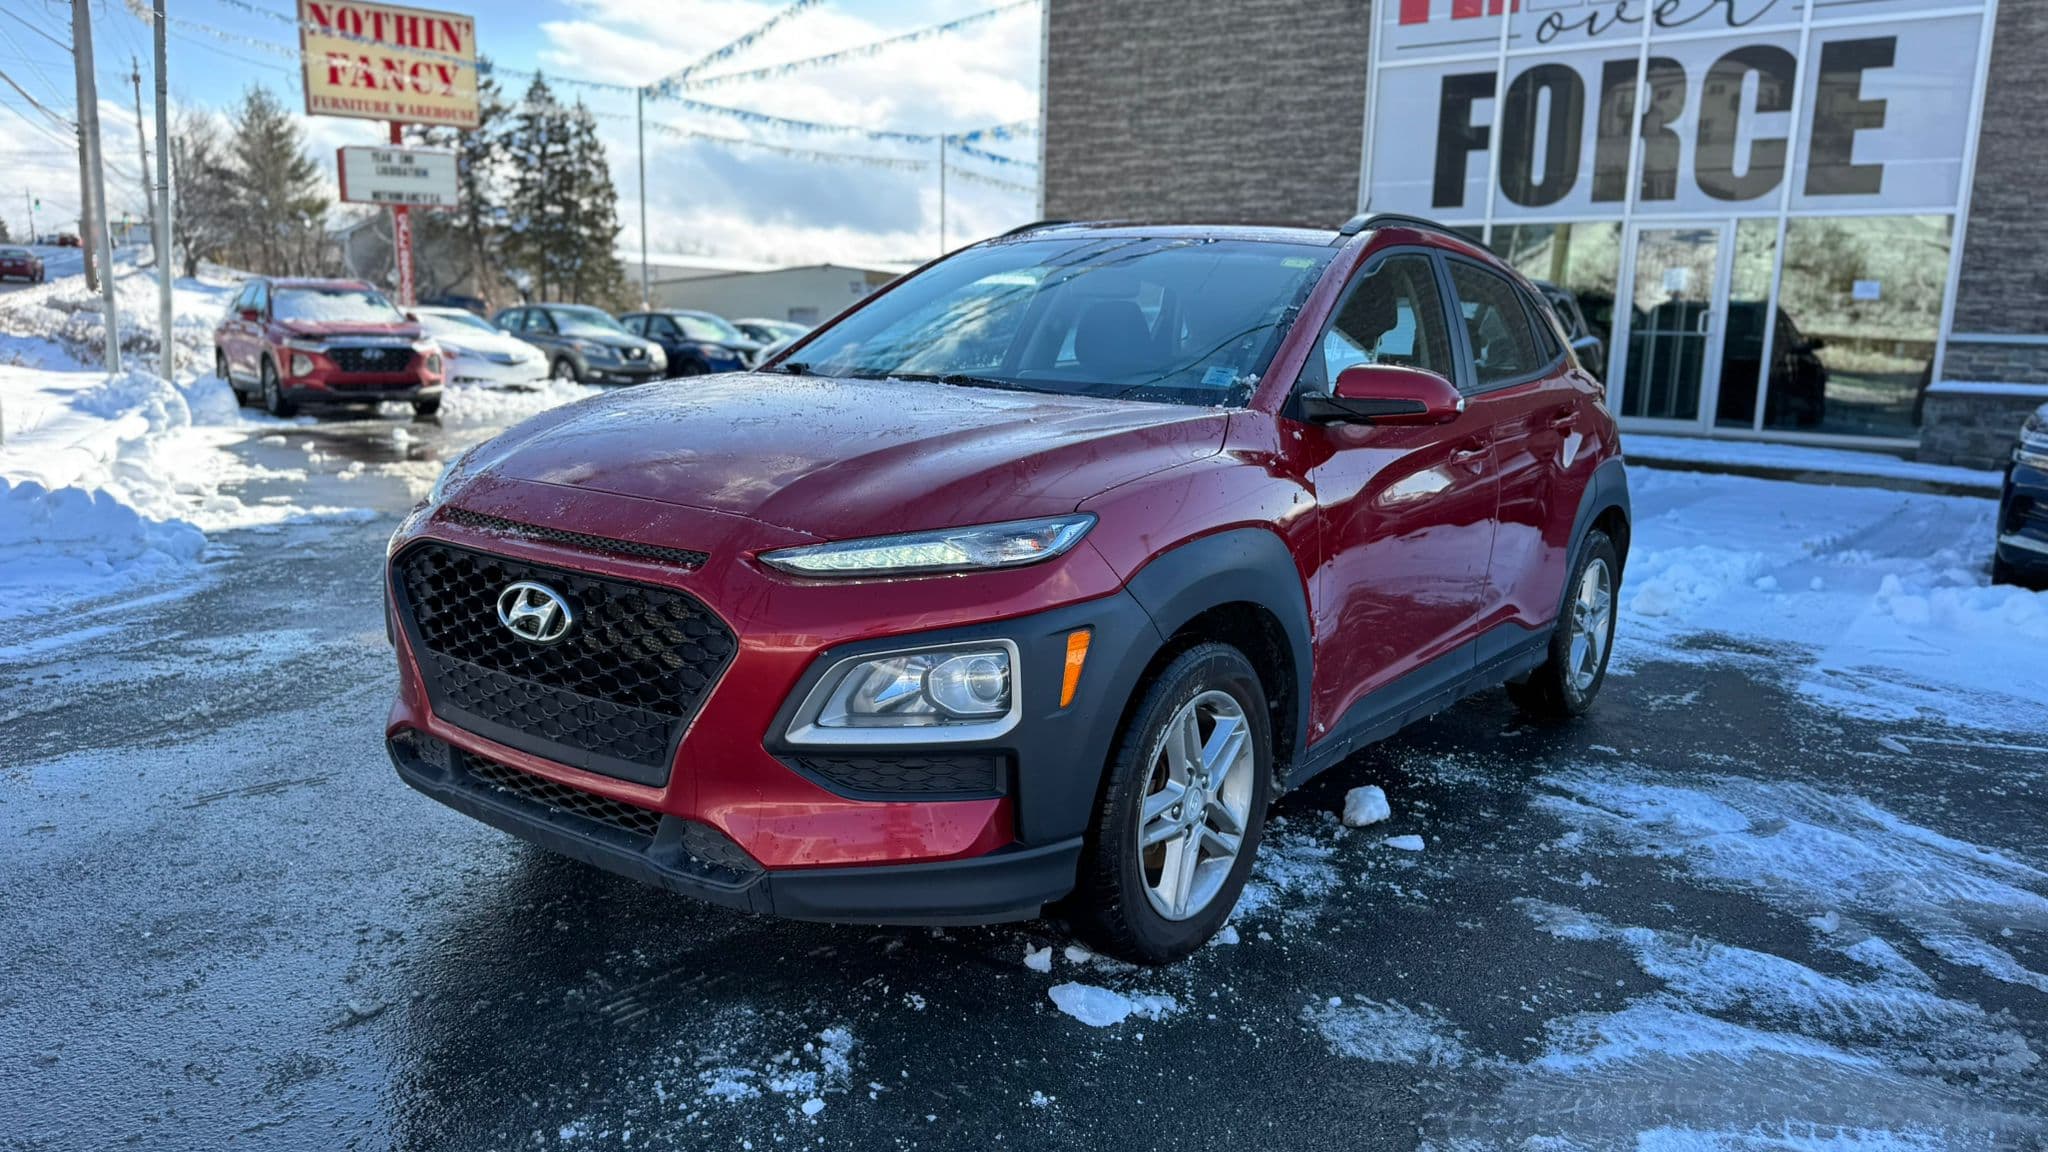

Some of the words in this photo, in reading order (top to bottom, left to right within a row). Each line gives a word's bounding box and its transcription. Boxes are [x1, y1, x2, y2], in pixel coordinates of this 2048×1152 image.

[1535, 0, 1778, 44] over
[326, 51, 460, 98] FANCY
[312, 95, 391, 114] FURNITURE
[395, 102, 476, 121] WAREHOUSE
[1431, 36, 1897, 209] FORCE
